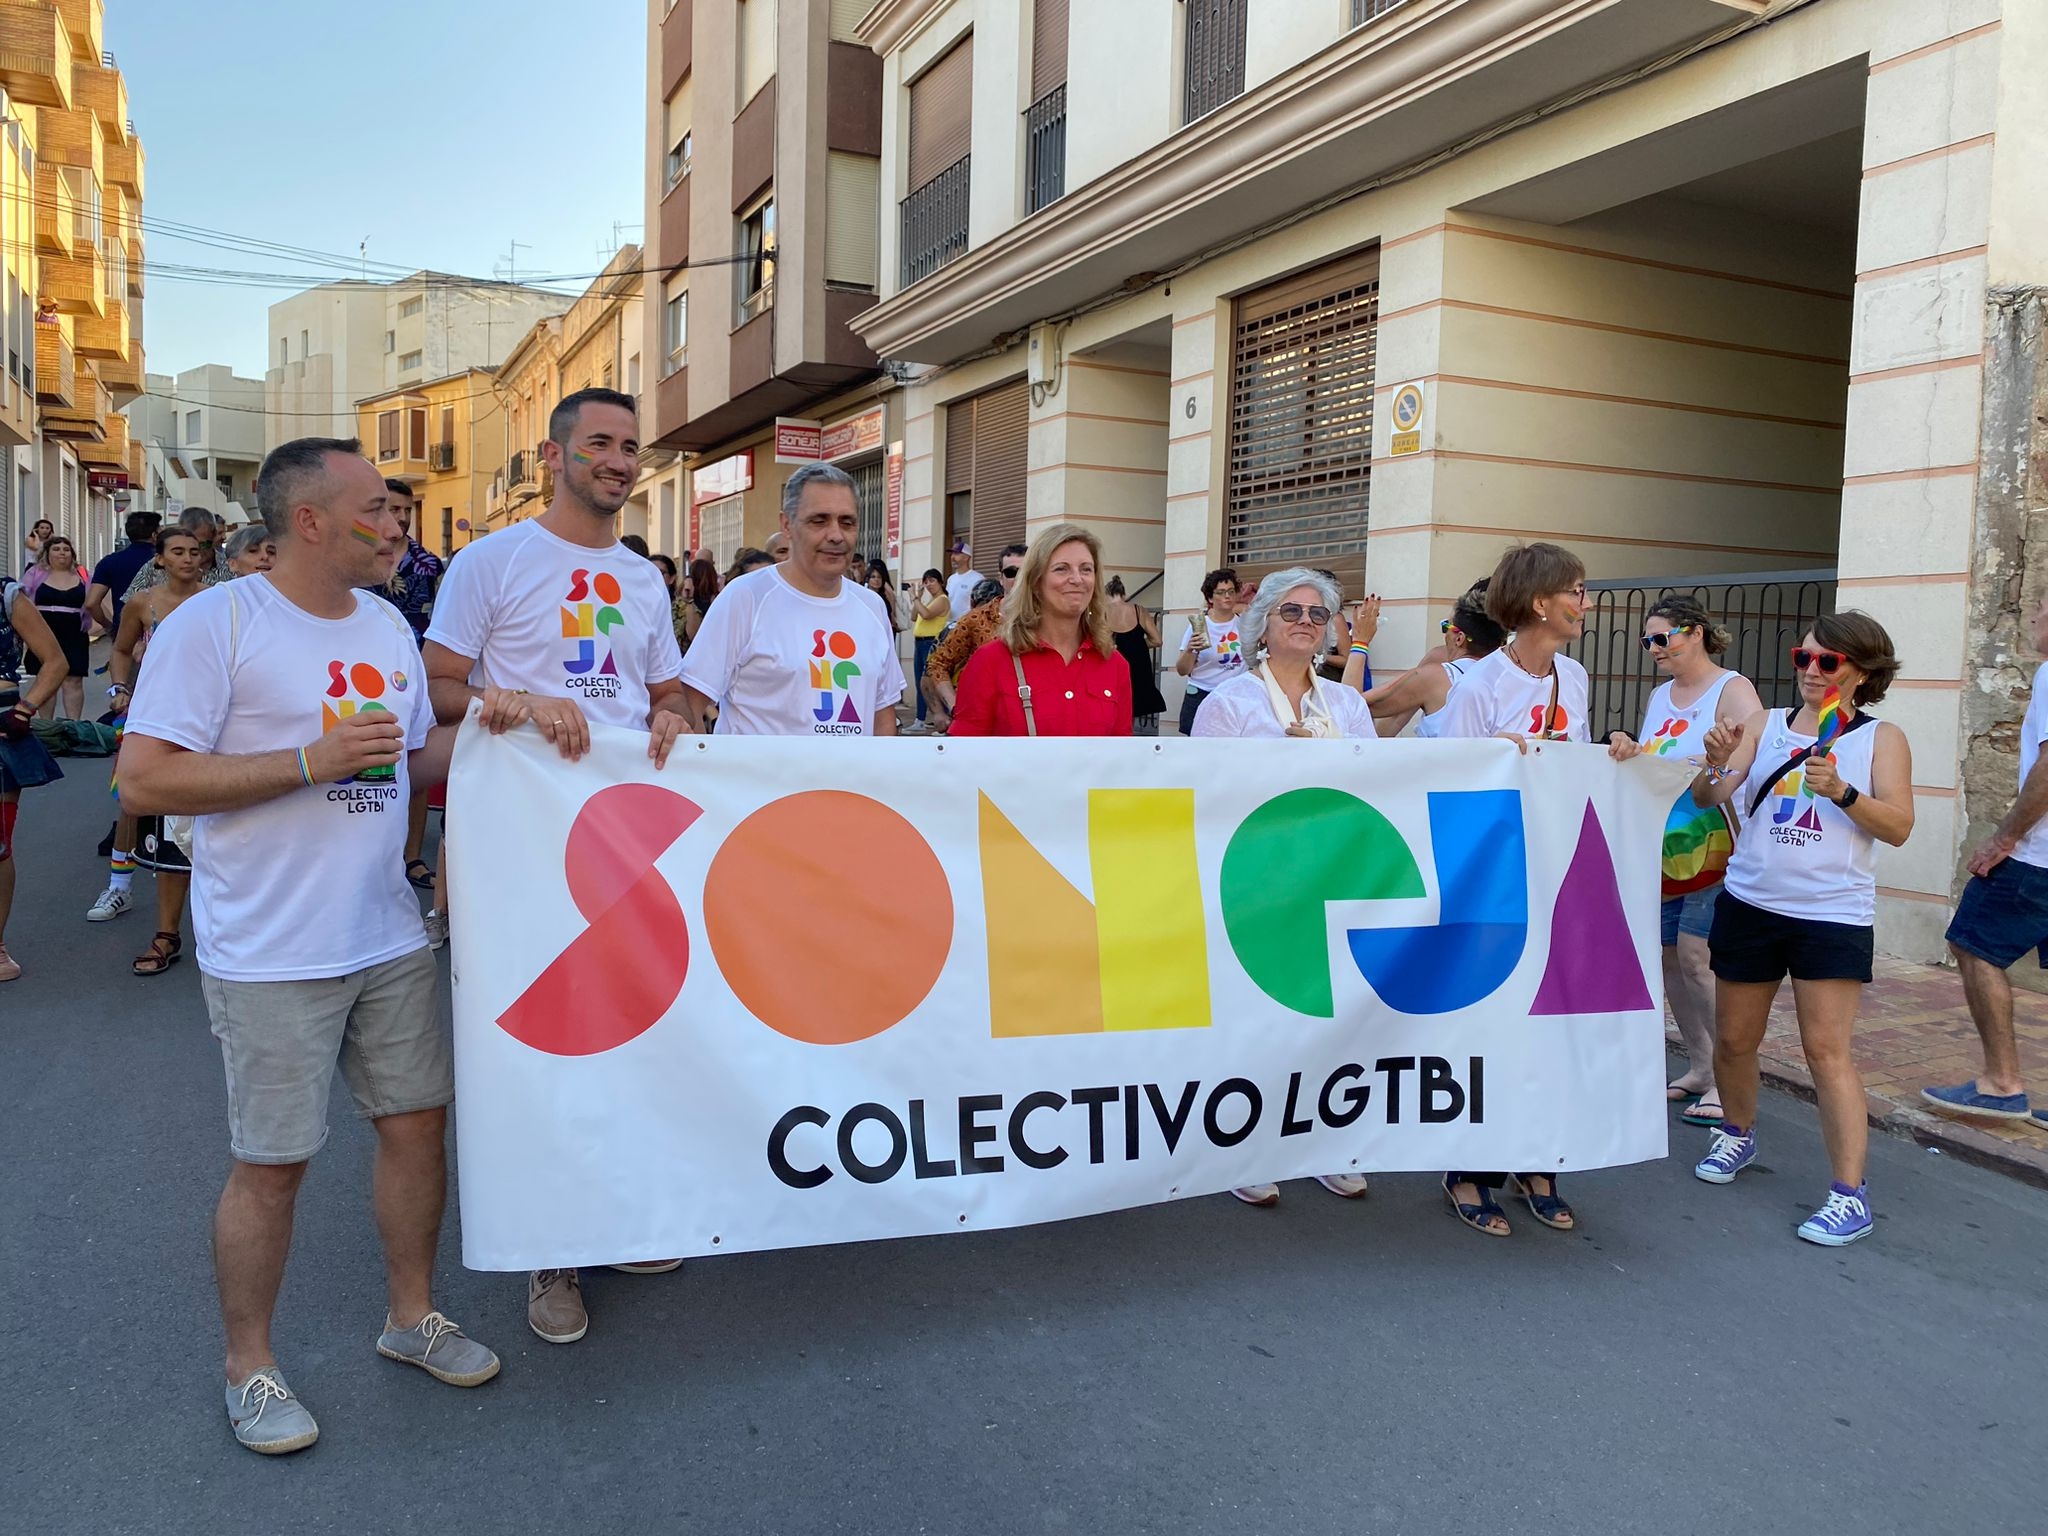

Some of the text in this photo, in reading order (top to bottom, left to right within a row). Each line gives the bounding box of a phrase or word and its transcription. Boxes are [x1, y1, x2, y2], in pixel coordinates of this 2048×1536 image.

[1185, 396, 1197, 419] 6
[778, 435, 820, 448] SONEJA
[565, 568, 621, 605] SO
[811, 629, 856, 660] SO
[563, 640, 619, 677] JA
[326, 660, 386, 699] SO
[584, 688, 617, 698] LGTBI
[813, 691, 862, 723] JA
[814, 724, 862, 735] COLECTIVO
[327, 788, 398, 801] COLECTIVO
[347, 801, 384, 813] LGTBI
[1769, 826, 1822, 842] COLECTIVO
[1776, 836, 1805, 847] LGTBI
[494, 782, 1656, 1057] SONEJA
[767, 1055, 1484, 1190] COLECTIVO LGTBI
